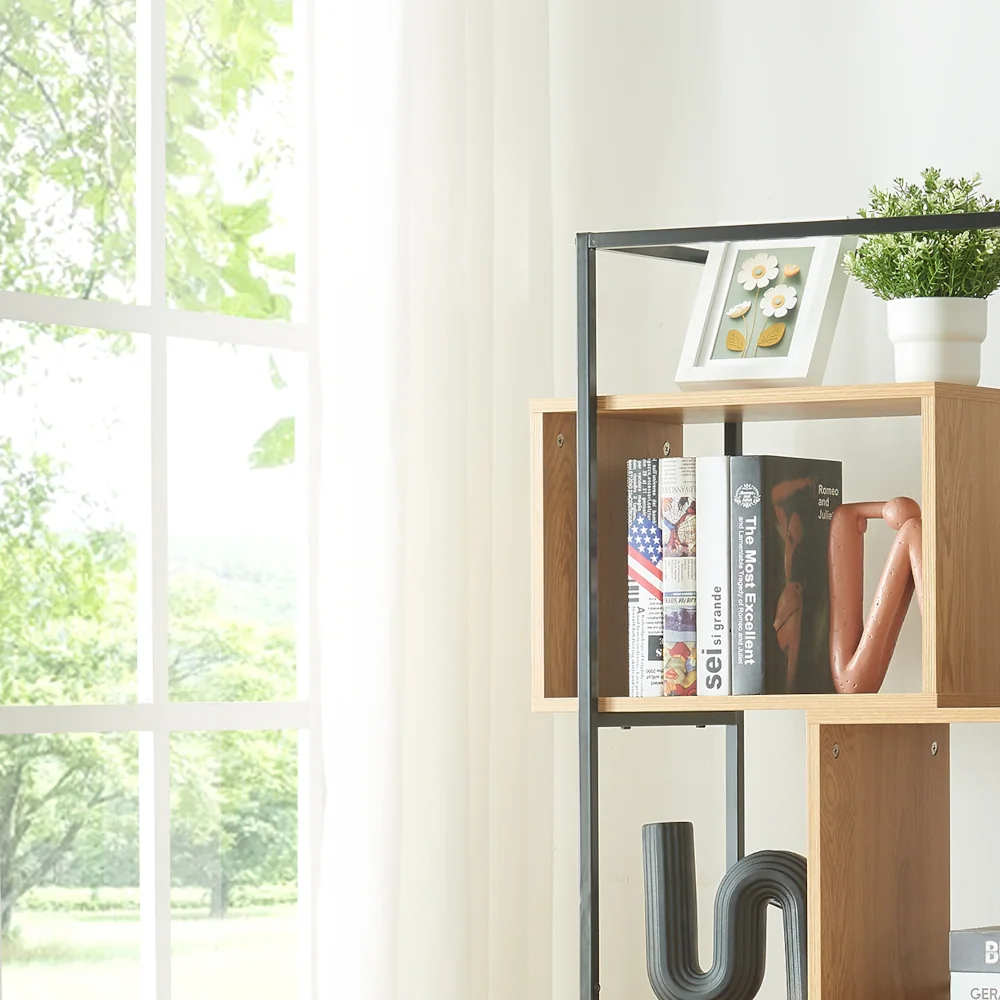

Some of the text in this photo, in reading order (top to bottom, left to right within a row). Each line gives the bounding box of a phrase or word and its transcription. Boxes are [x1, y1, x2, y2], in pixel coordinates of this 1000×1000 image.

[818, 484, 840, 496] Romeo
[818, 497, 830, 507] and
[744, 516, 757, 545] The
[744, 550, 757, 588] Most
[738, 599, 744, 607] of
[702, 586, 725, 690] sei si grande
[744, 593, 756, 665] Excellent
